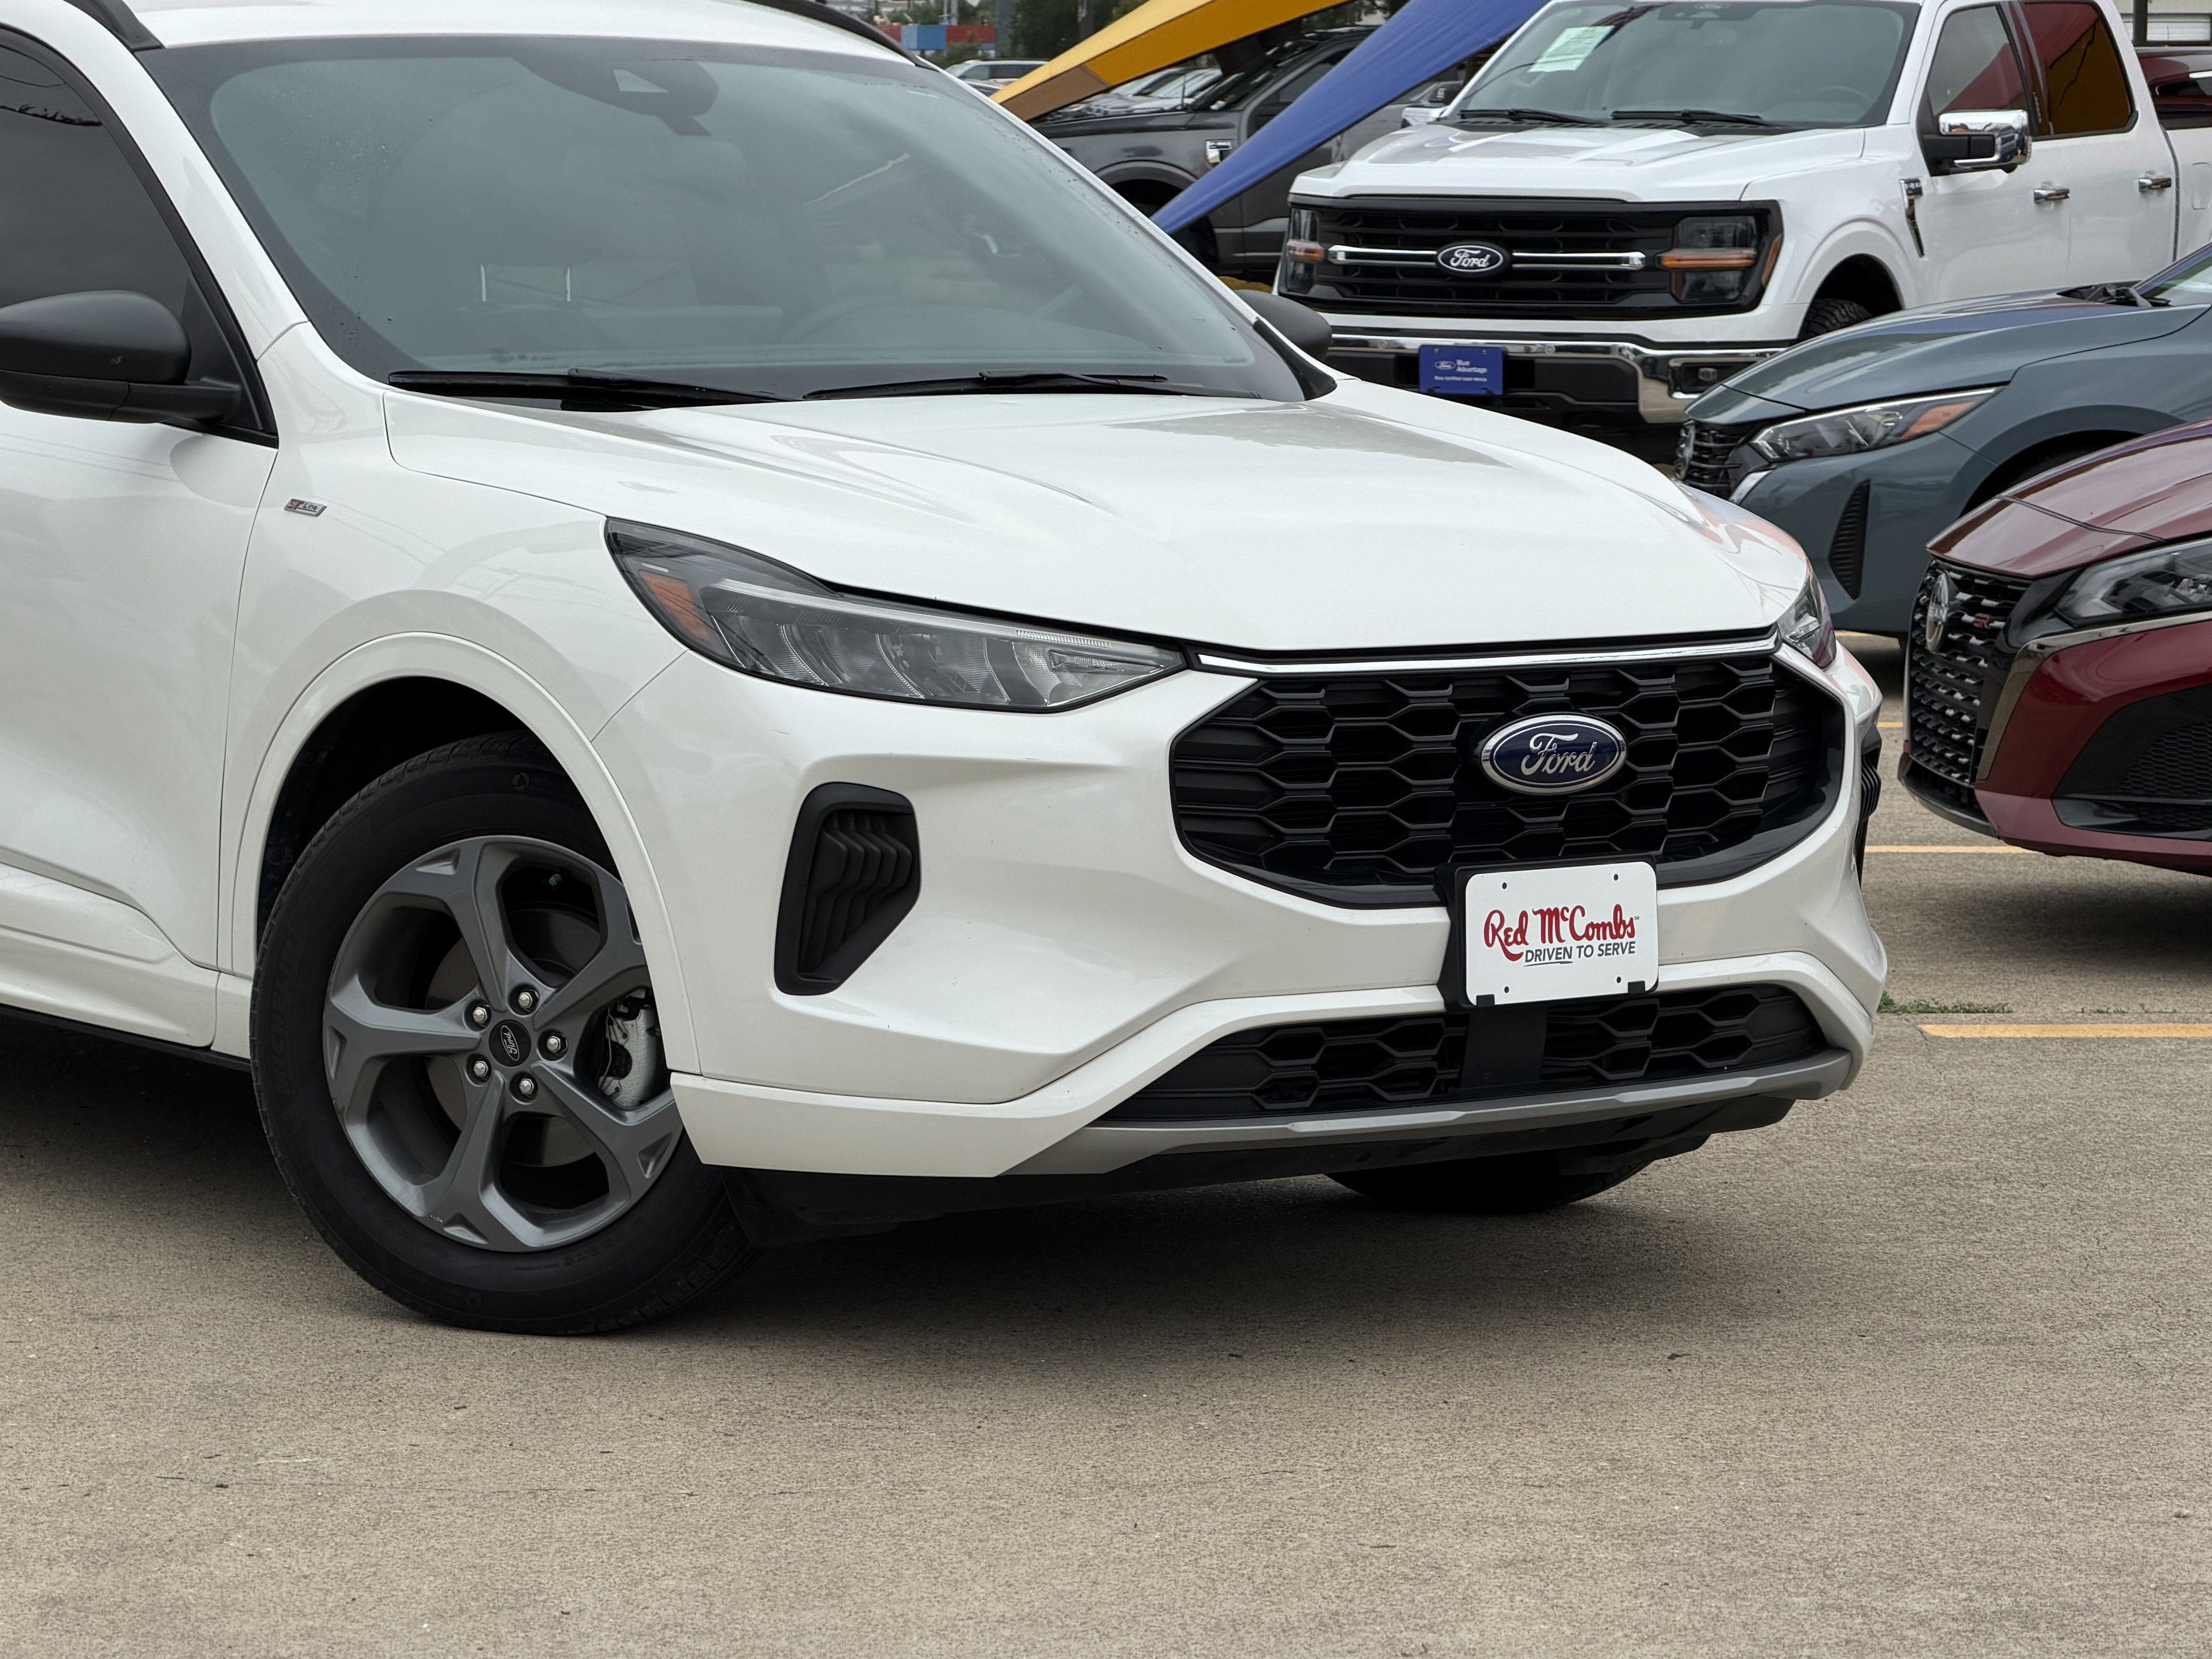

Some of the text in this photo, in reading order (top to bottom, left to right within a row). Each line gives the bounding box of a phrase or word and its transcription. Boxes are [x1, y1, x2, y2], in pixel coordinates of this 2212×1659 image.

[1449, 248, 1491, 268] Ford
[1520, 732, 1598, 776] Ford
[1484, 910, 1529, 962] Red
[1532, 904, 1636, 944] McCombs
[1525, 941, 1636, 963] DRIVEN TO SERVE
[503, 1032, 518, 1054] Ford
